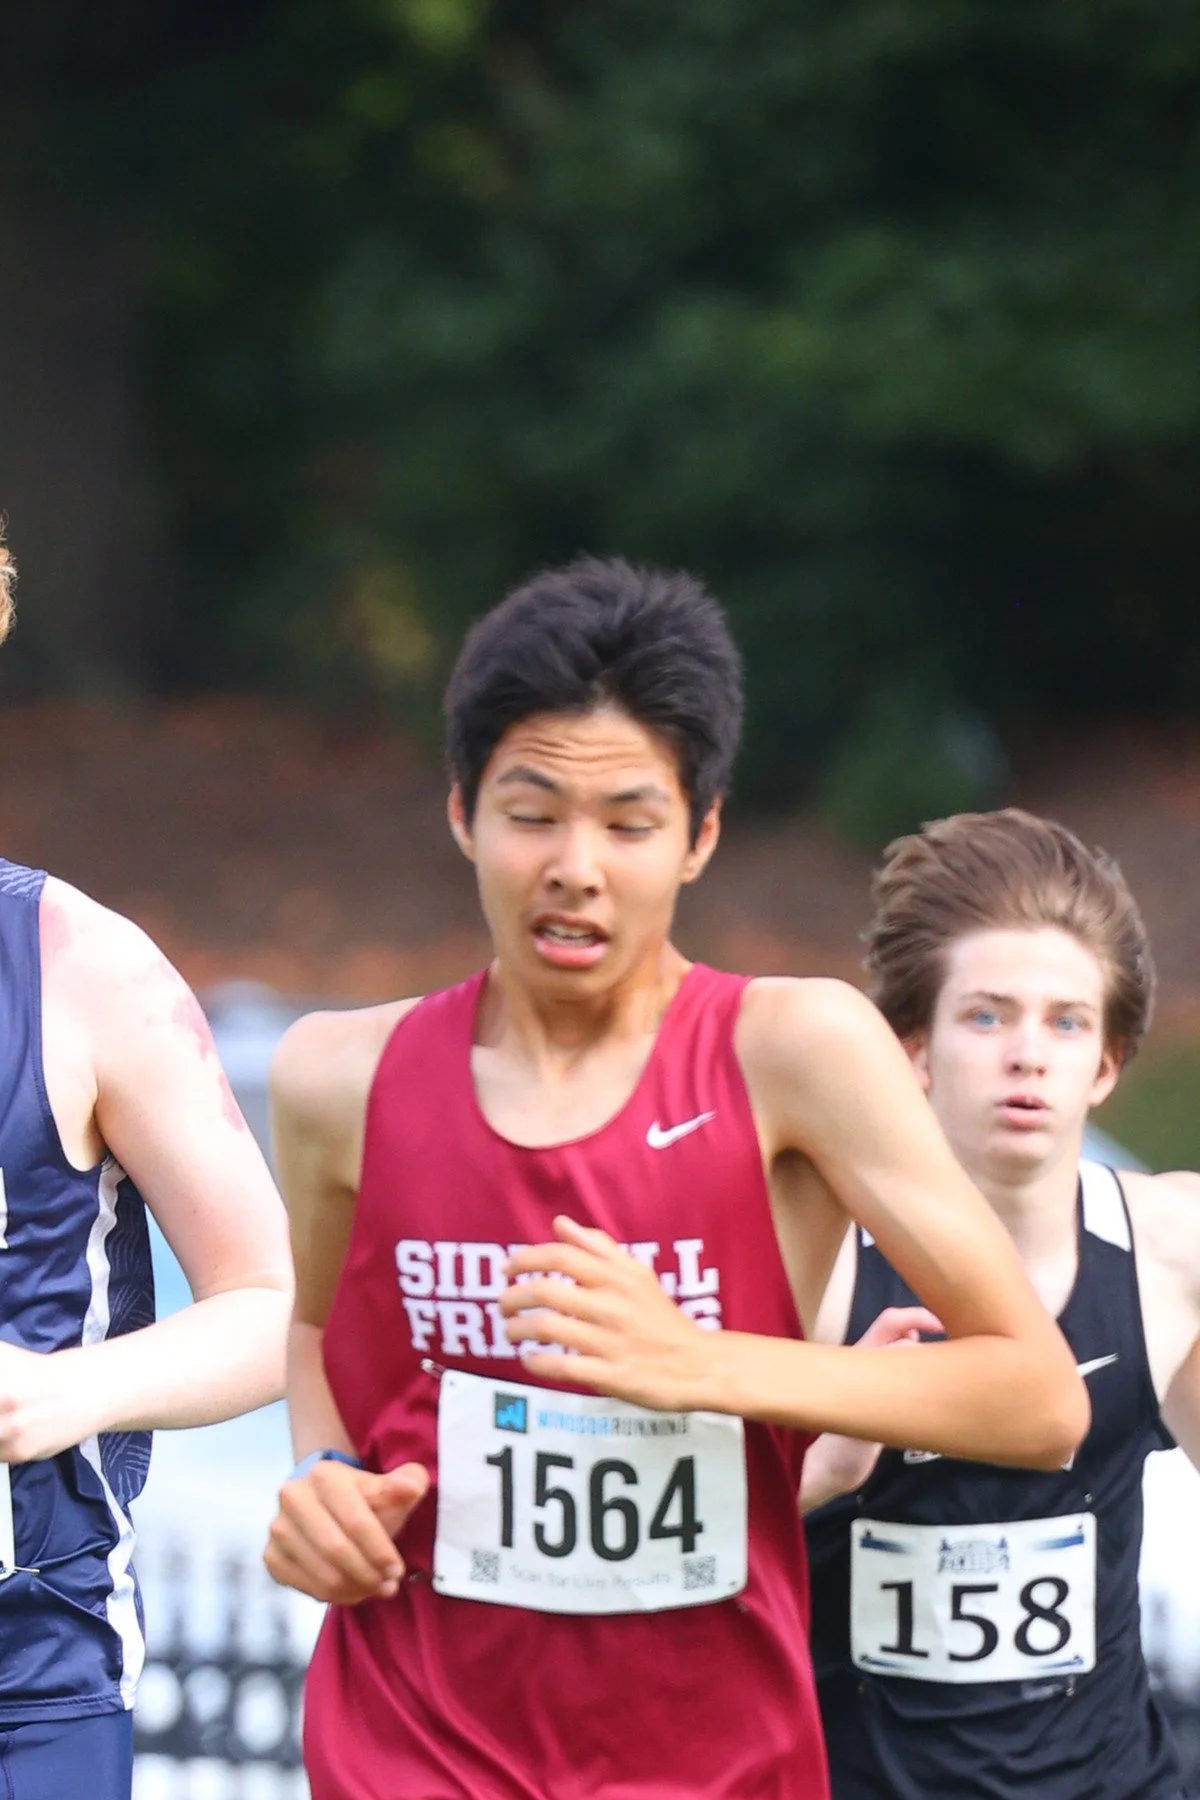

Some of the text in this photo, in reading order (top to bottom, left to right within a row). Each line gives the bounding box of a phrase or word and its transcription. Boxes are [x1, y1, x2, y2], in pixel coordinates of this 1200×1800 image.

[394, 1238, 720, 1300] SIDLL
[401, 1296, 722, 1360] FRIS
[485, 1444, 703, 1562] 1564
[879, 1576, 1072, 1662] 158
